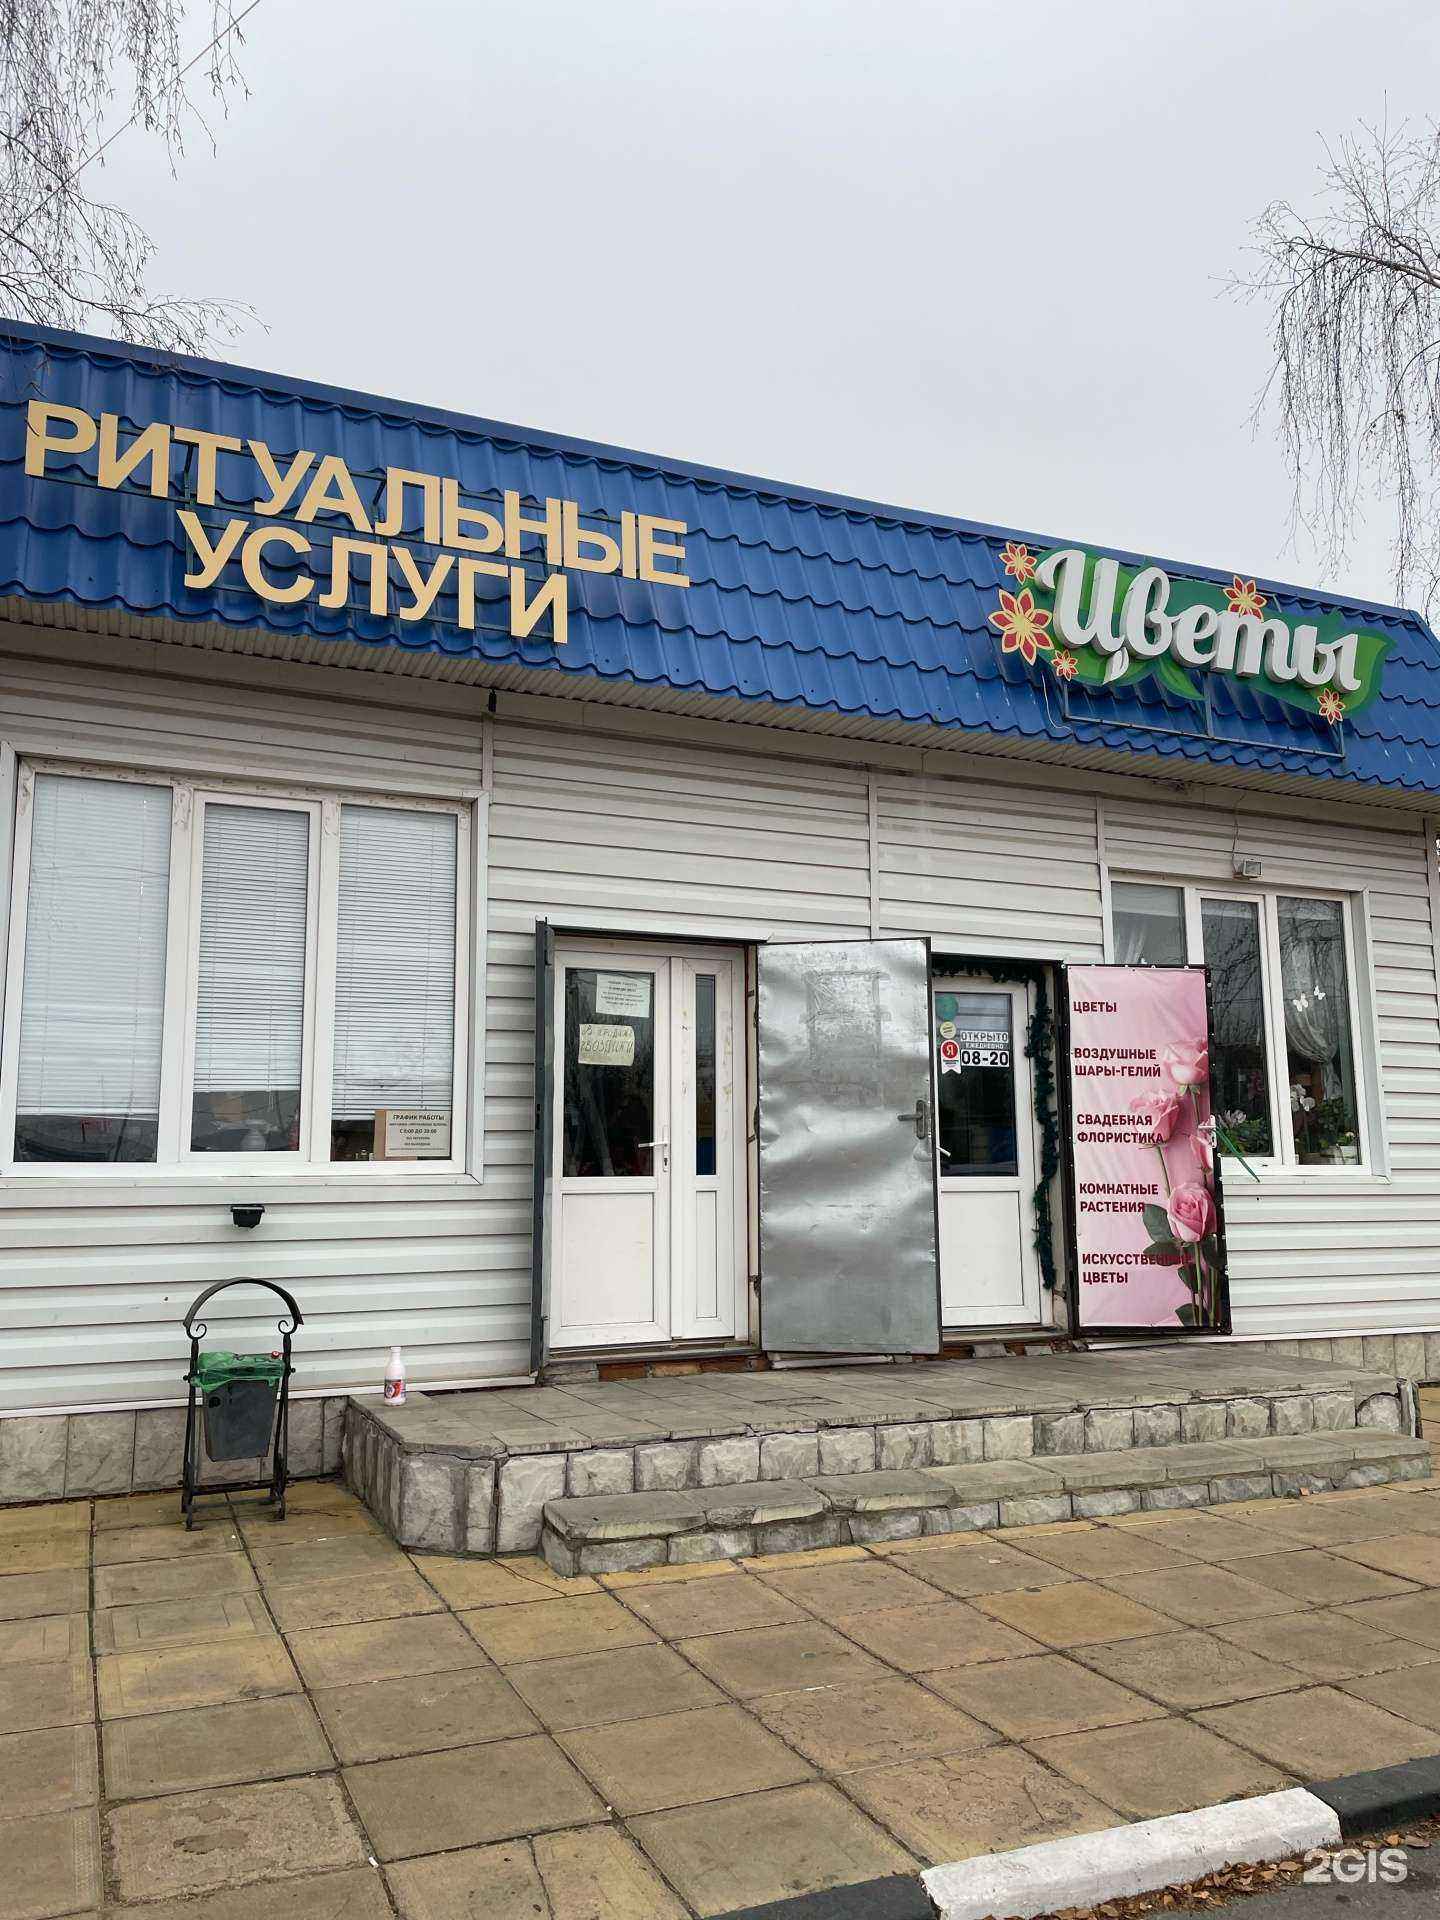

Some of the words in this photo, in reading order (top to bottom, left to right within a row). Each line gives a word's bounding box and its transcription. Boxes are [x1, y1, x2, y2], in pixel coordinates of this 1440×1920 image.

[25, 399, 690, 588] РИТУАЛЬНЫЕ
[176, 509, 568, 645] УСЛУГИ
[1034, 548, 1362, 693] Цветы
[1073, 1001, 1117, 1013] ЦВЕТЫ
[961, 1032, 1008, 1041] ОТКРЫТО
[961, 1051, 1009, 1065] 08-20
[1074, 1047, 1157, 1060] ВОЗДУШНЫЕ
[1075, 1064, 1161, 1077] ШАРЫ-ГЕЛИЙ
[1077, 1114, 1152, 1127] СВАДЕБНАЯ
[1077, 1131, 1164, 1144] ФЛОРИСТИКА
[1079, 1183, 1159, 1195] КОМНАТНЫЕ
[1080, 1201, 1146, 1213] РАСТЕНИЯ
[1083, 1272, 1128, 1285] ЦВЕТЫ
